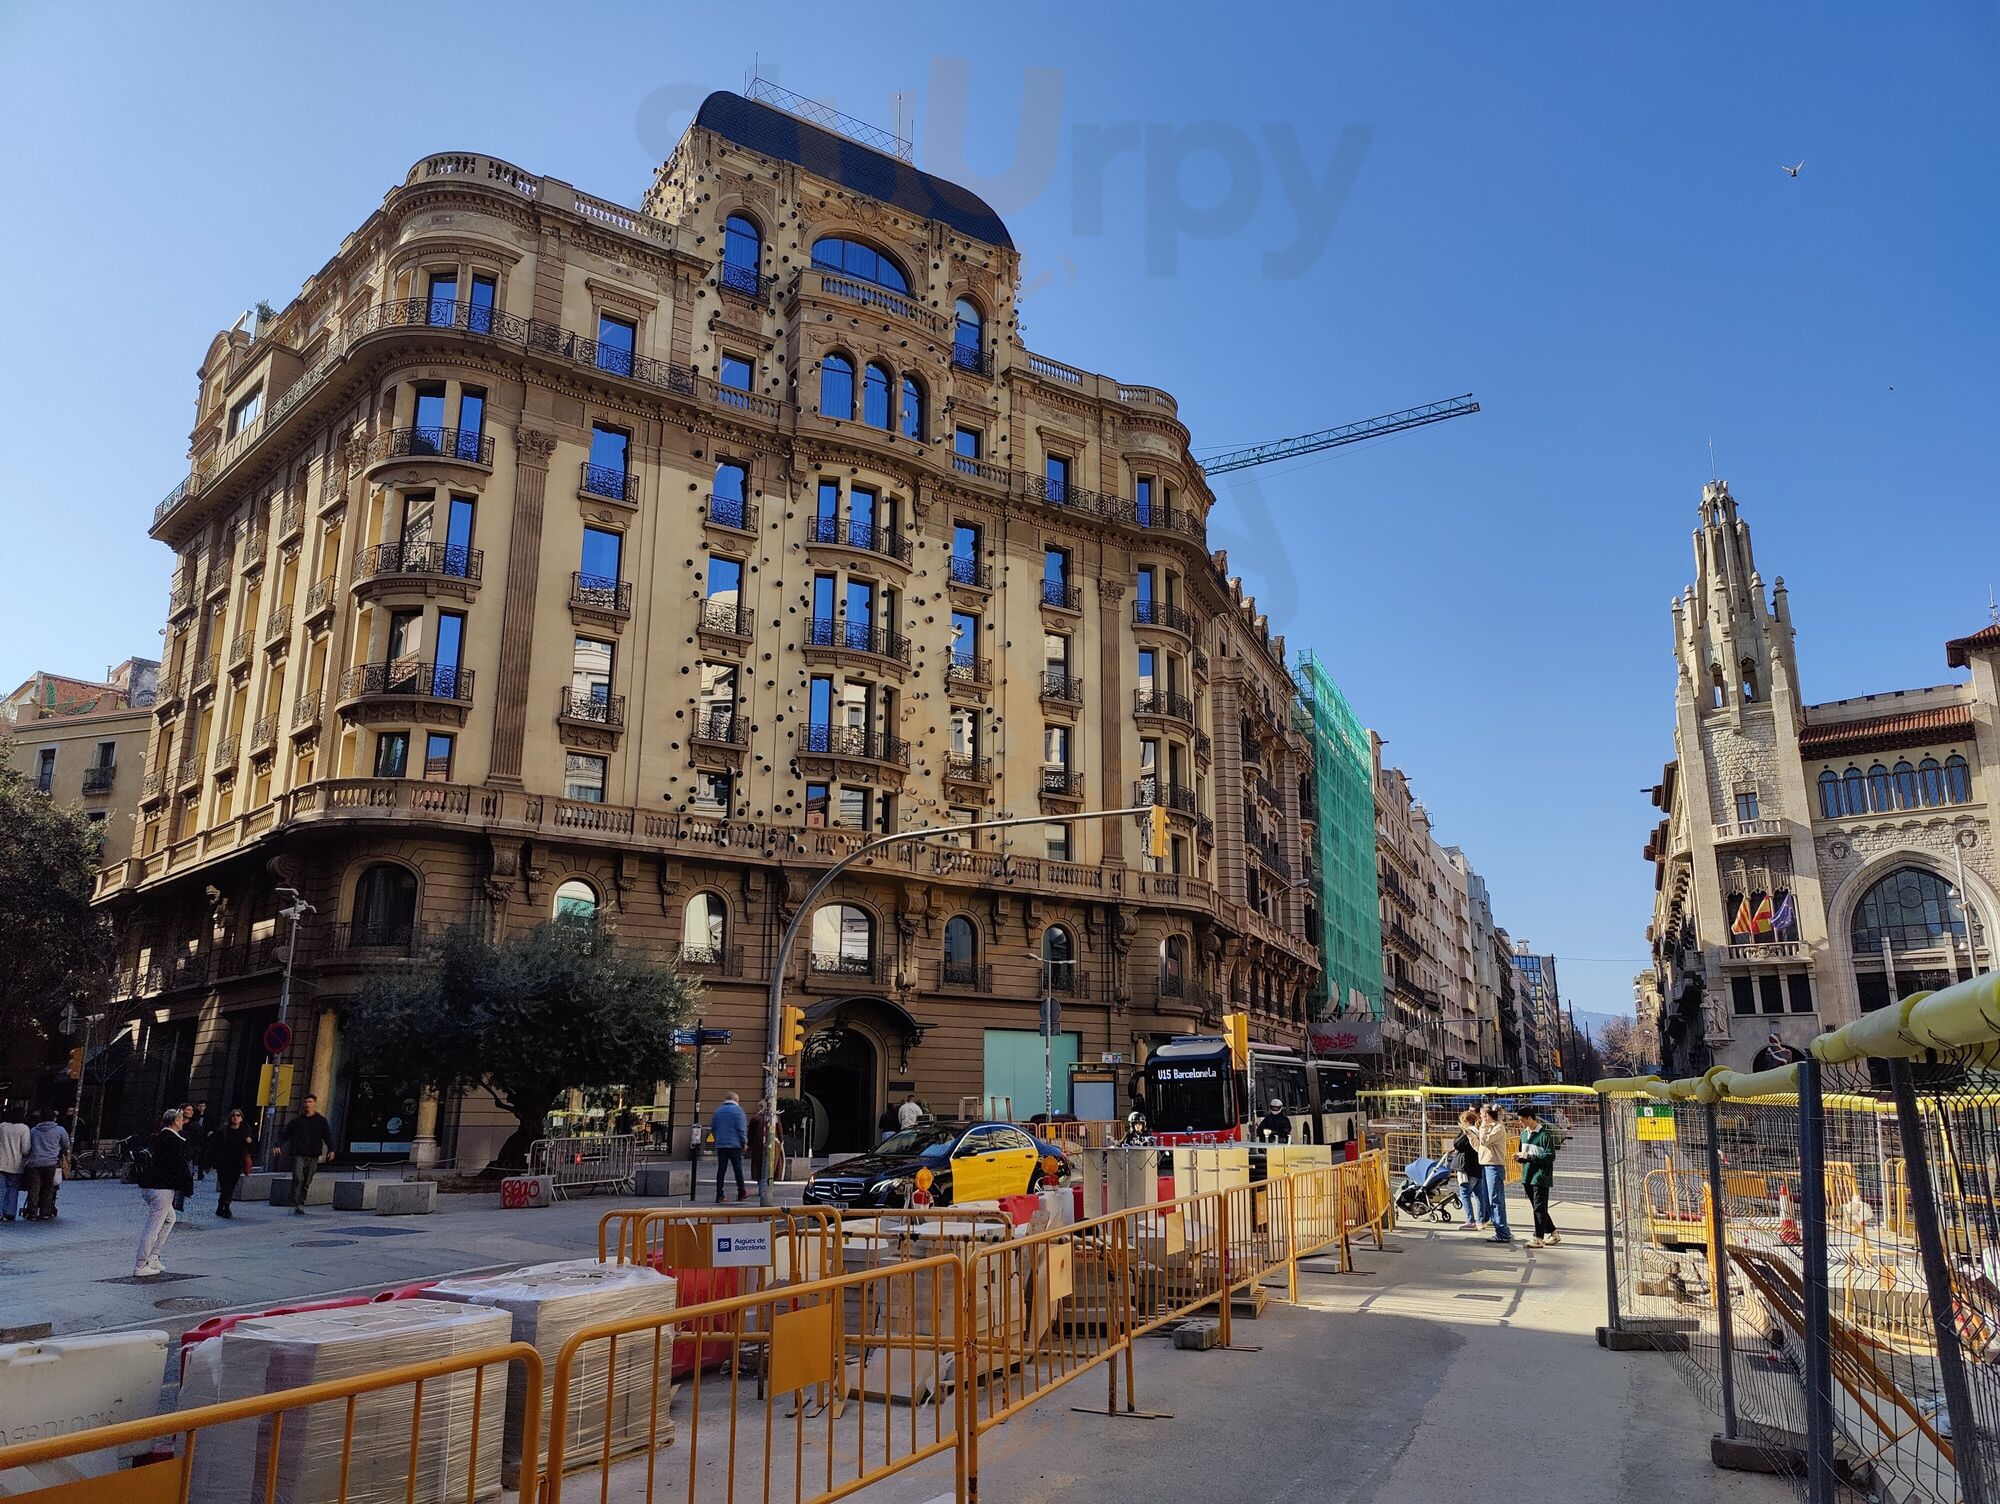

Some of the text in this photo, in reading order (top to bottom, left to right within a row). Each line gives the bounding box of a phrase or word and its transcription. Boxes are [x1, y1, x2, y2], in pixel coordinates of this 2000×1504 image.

[1173, 1067, 1217, 1079] Barceloneta
[734, 1237, 766, 1246] Aigües de
[734, 1244, 767, 1252] Barcelona
